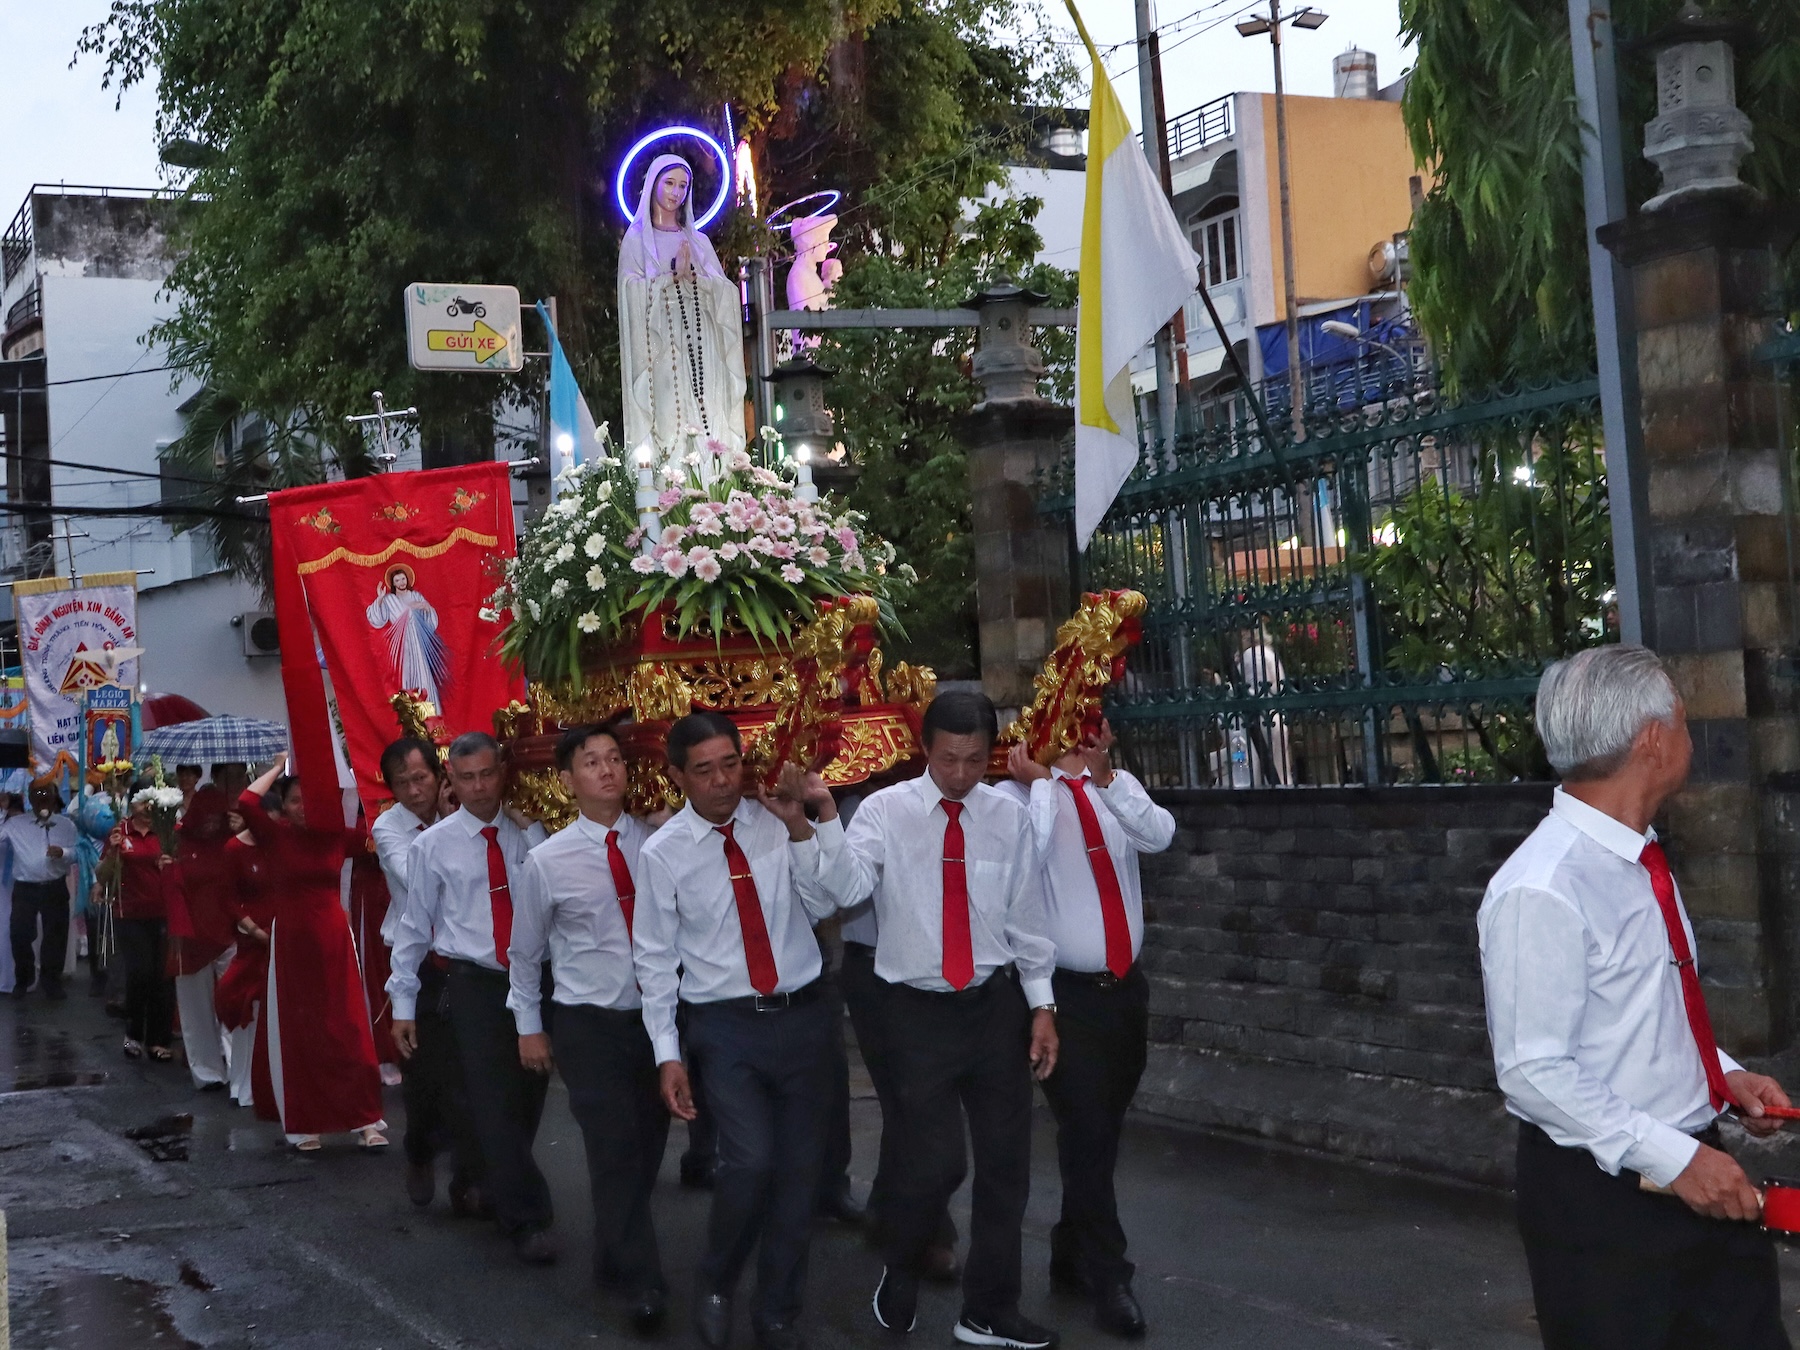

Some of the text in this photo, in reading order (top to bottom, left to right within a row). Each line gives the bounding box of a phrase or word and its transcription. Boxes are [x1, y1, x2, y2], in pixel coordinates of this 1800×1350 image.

[446, 333, 495, 349] GỬI XE
[27, 636, 40, 651] GIA
[51, 599, 84, 620] NGUYỆN
[87, 601, 102, 613] XIN
[121, 626, 135, 639] AN
[95, 690, 124, 699] LEGIO
[47, 732, 65, 745] LIÊN
